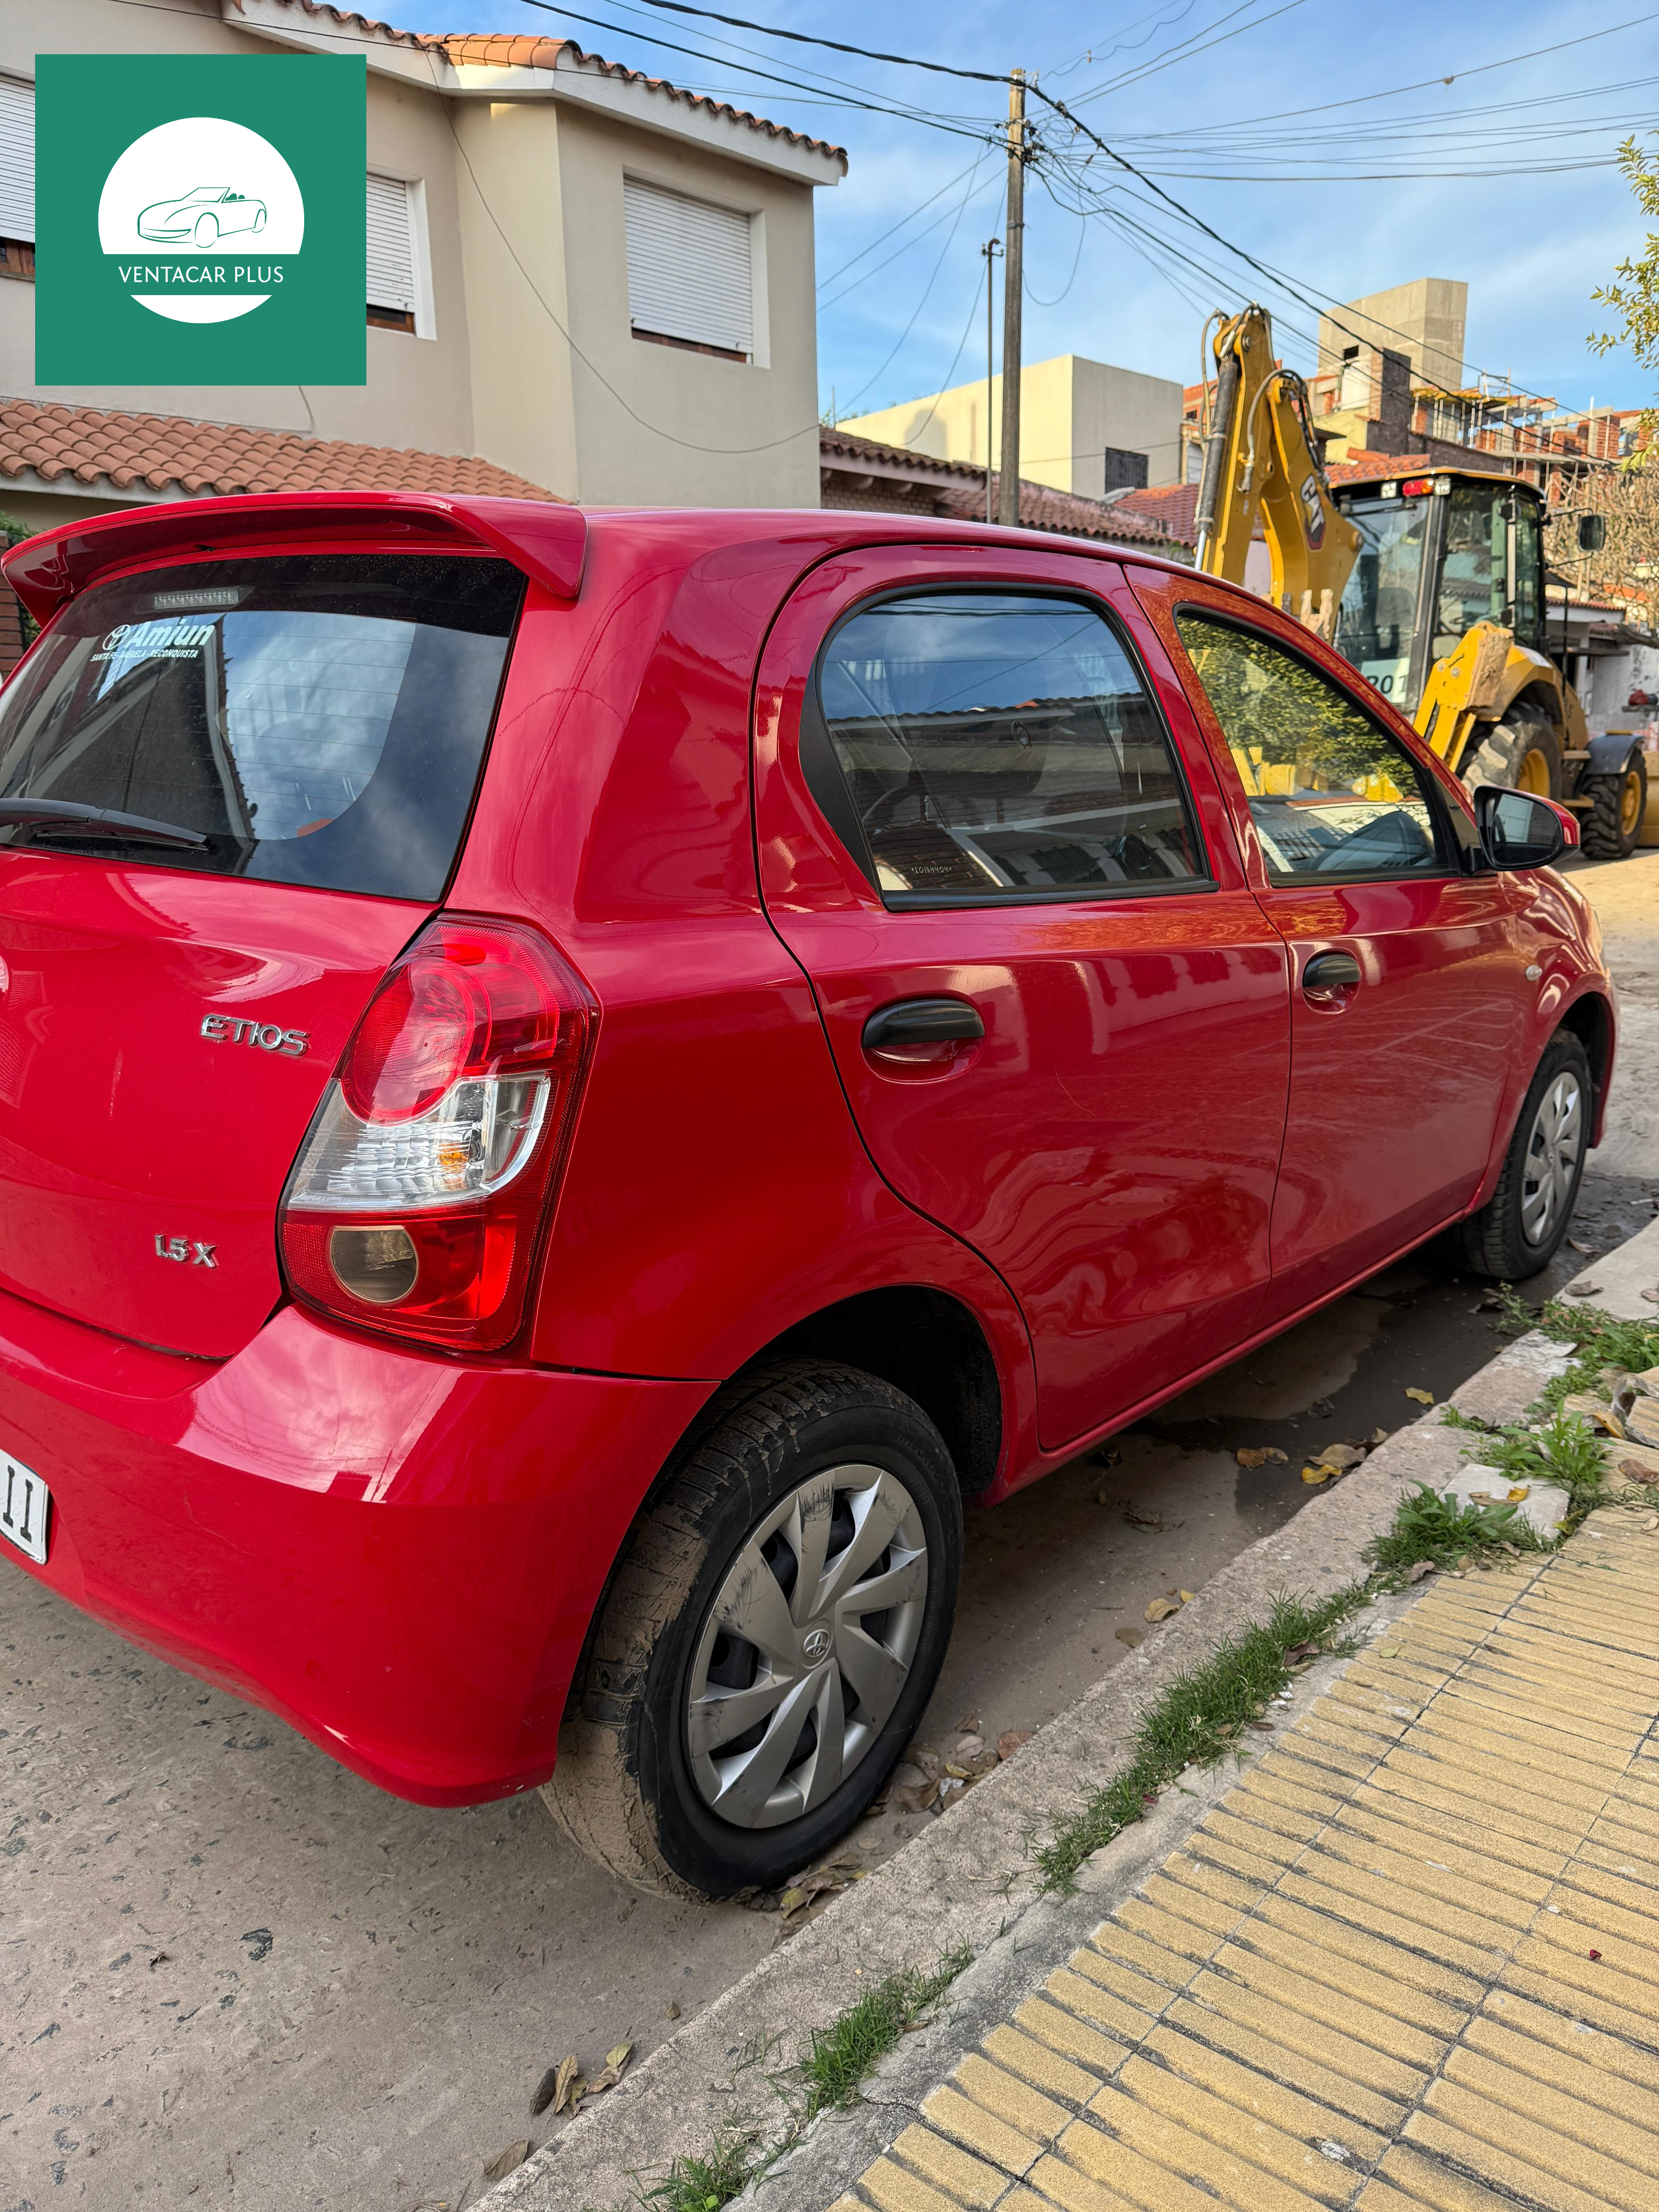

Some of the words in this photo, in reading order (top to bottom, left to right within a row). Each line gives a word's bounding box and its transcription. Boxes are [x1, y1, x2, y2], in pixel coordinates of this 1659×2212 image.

[1301, 473, 1326, 533] CAT
[124, 618, 215, 648] Amiun
[150, 649, 199, 658] RECONQUISTA
[200, 1013, 311, 1056] ETIOS
[192, 1242, 216, 1268] X
